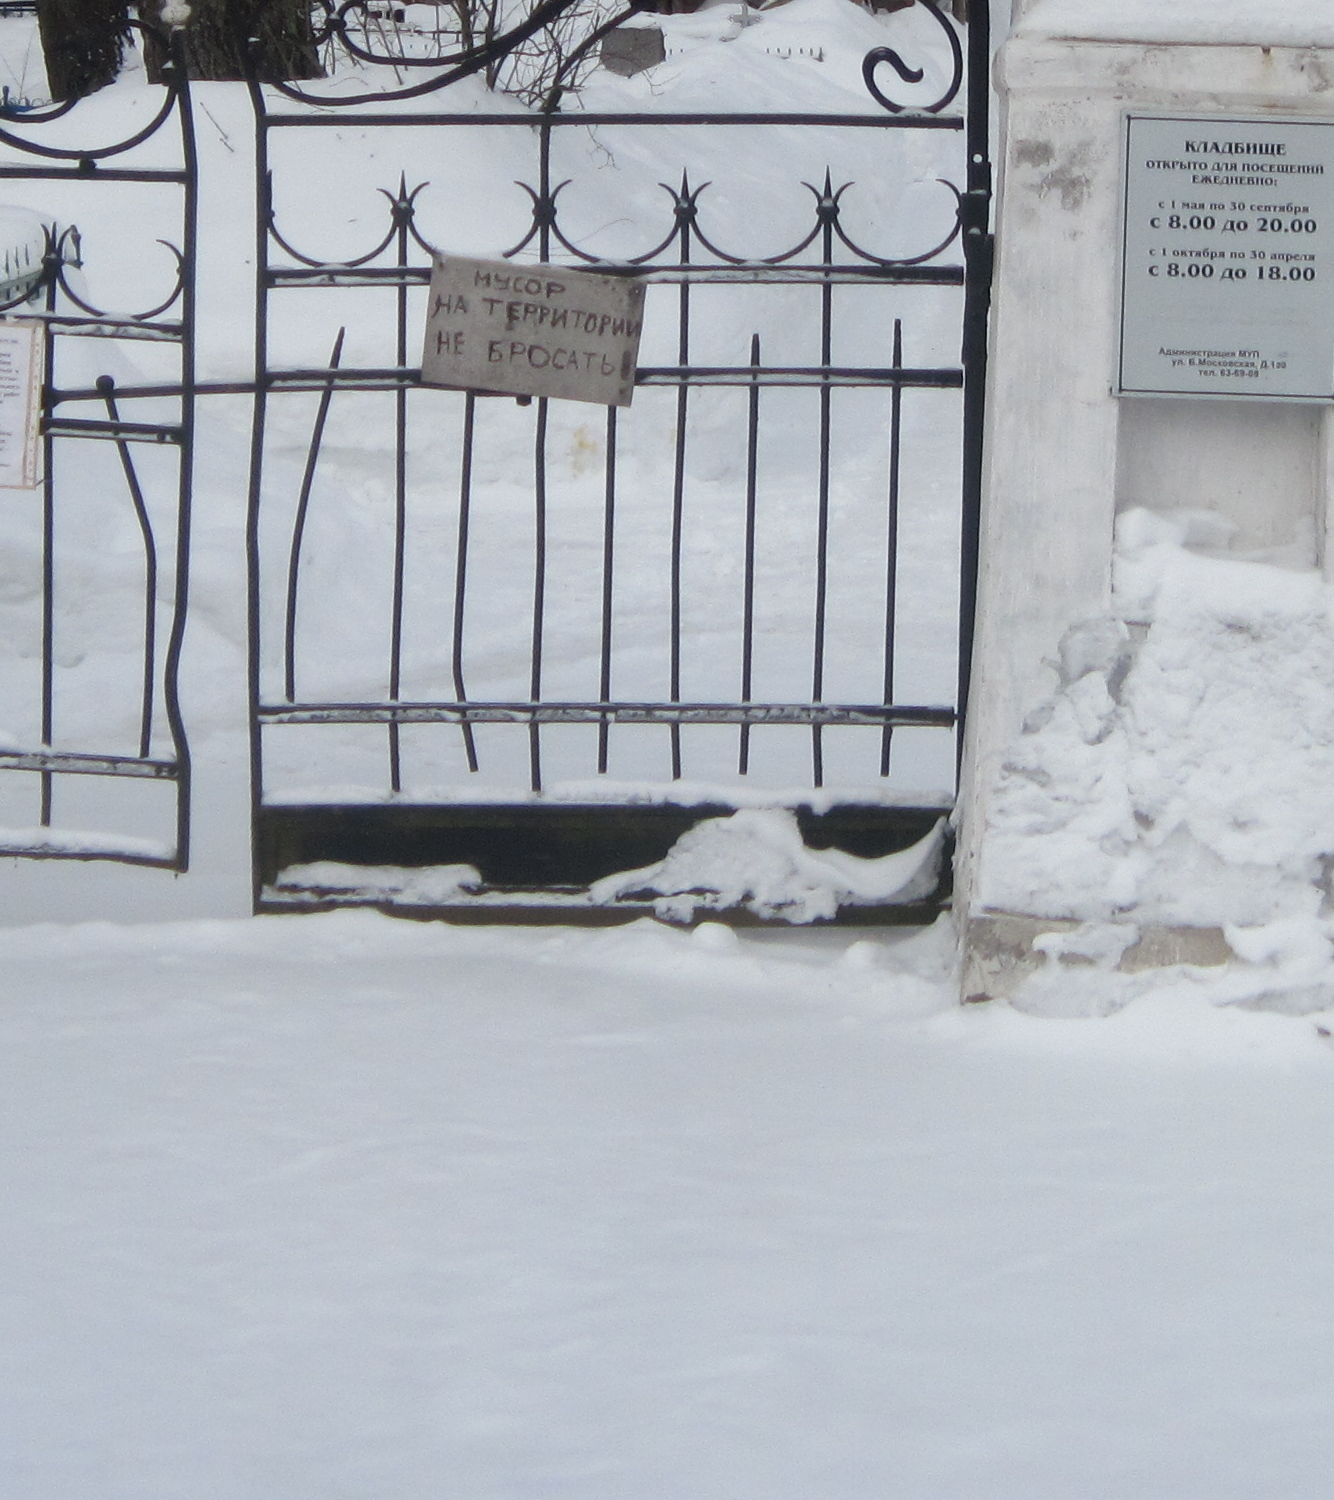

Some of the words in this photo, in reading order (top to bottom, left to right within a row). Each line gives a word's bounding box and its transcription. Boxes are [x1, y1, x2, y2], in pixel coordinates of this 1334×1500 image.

[1185, 141, 1287, 155] КЛАДБИЩЕ
[1146, 160, 1208, 170] ОТКРЫТО
[1212, 162, 1237, 172] ДЛЯ
[1192, 175, 1278, 187] ЕЖЕДНЕВНО:
[1158, 201, 1165, 209] с
[1181, 202, 1205, 211] мая
[1209, 203, 1225, 211] по
[1230, 202, 1246, 211] 30
[1249, 202, 1310, 216] сентября
[1150, 217, 1161, 229] с
[1168, 215, 1216, 230] 8.00
[1221, 219, 1248, 234] до
[1257, 218, 1317, 233] 20.00
[1149, 249, 1156, 257] с
[1172, 249, 1225, 261] октября
[1250, 251, 1266, 260] 30
[1270, 253, 1316, 263] апреля
[1148, 265, 1159, 277] с
[1167, 263, 1215, 278] 8.00
[1220, 267, 1247, 282] до
[1257, 266, 1316, 281] 18.00
[474, 270, 566, 299] МУСОР
[431, 294, 468, 319] НА
[482, 297, 640, 338] ТЕРРИТОРИИ
[436, 330, 466, 355] НЕ
